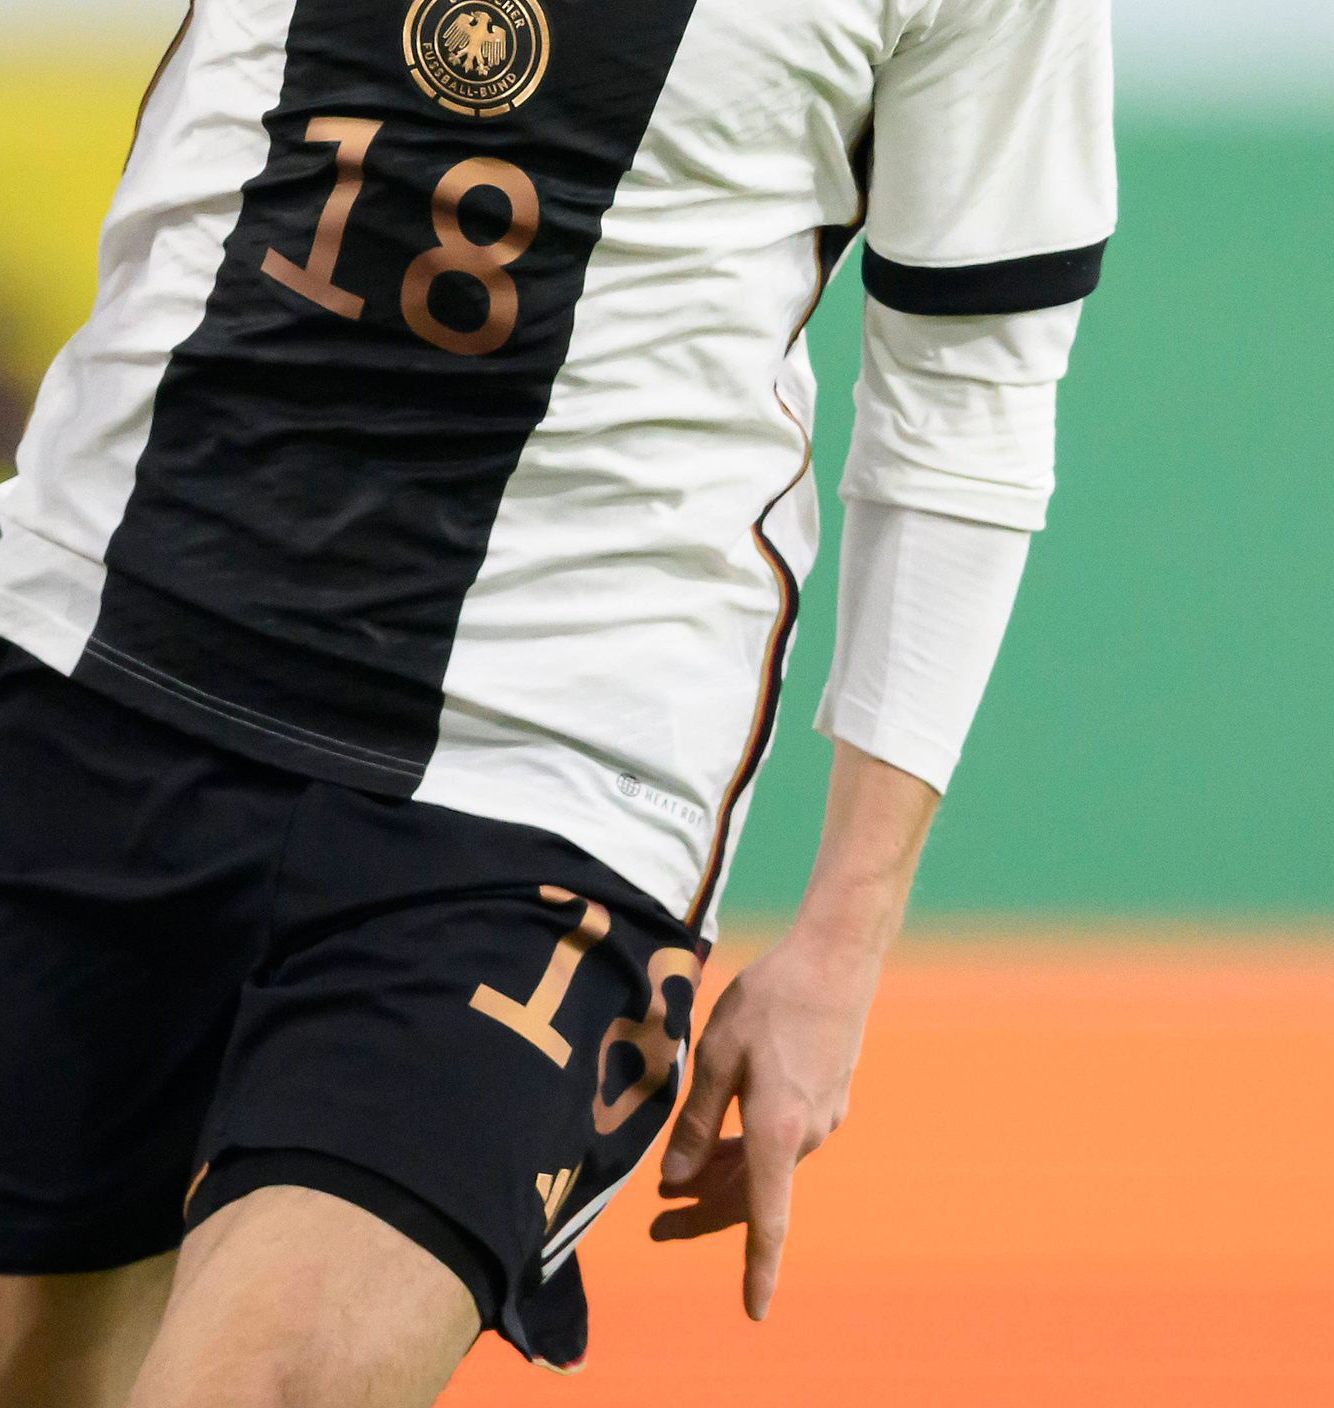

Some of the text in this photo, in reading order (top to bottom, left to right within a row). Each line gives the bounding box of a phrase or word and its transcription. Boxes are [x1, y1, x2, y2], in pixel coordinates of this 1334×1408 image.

[423, 42, 517, 98] FUSSBALL-BUND
[261, 117, 539, 355] 18
[469, 885, 701, 1135] 18
